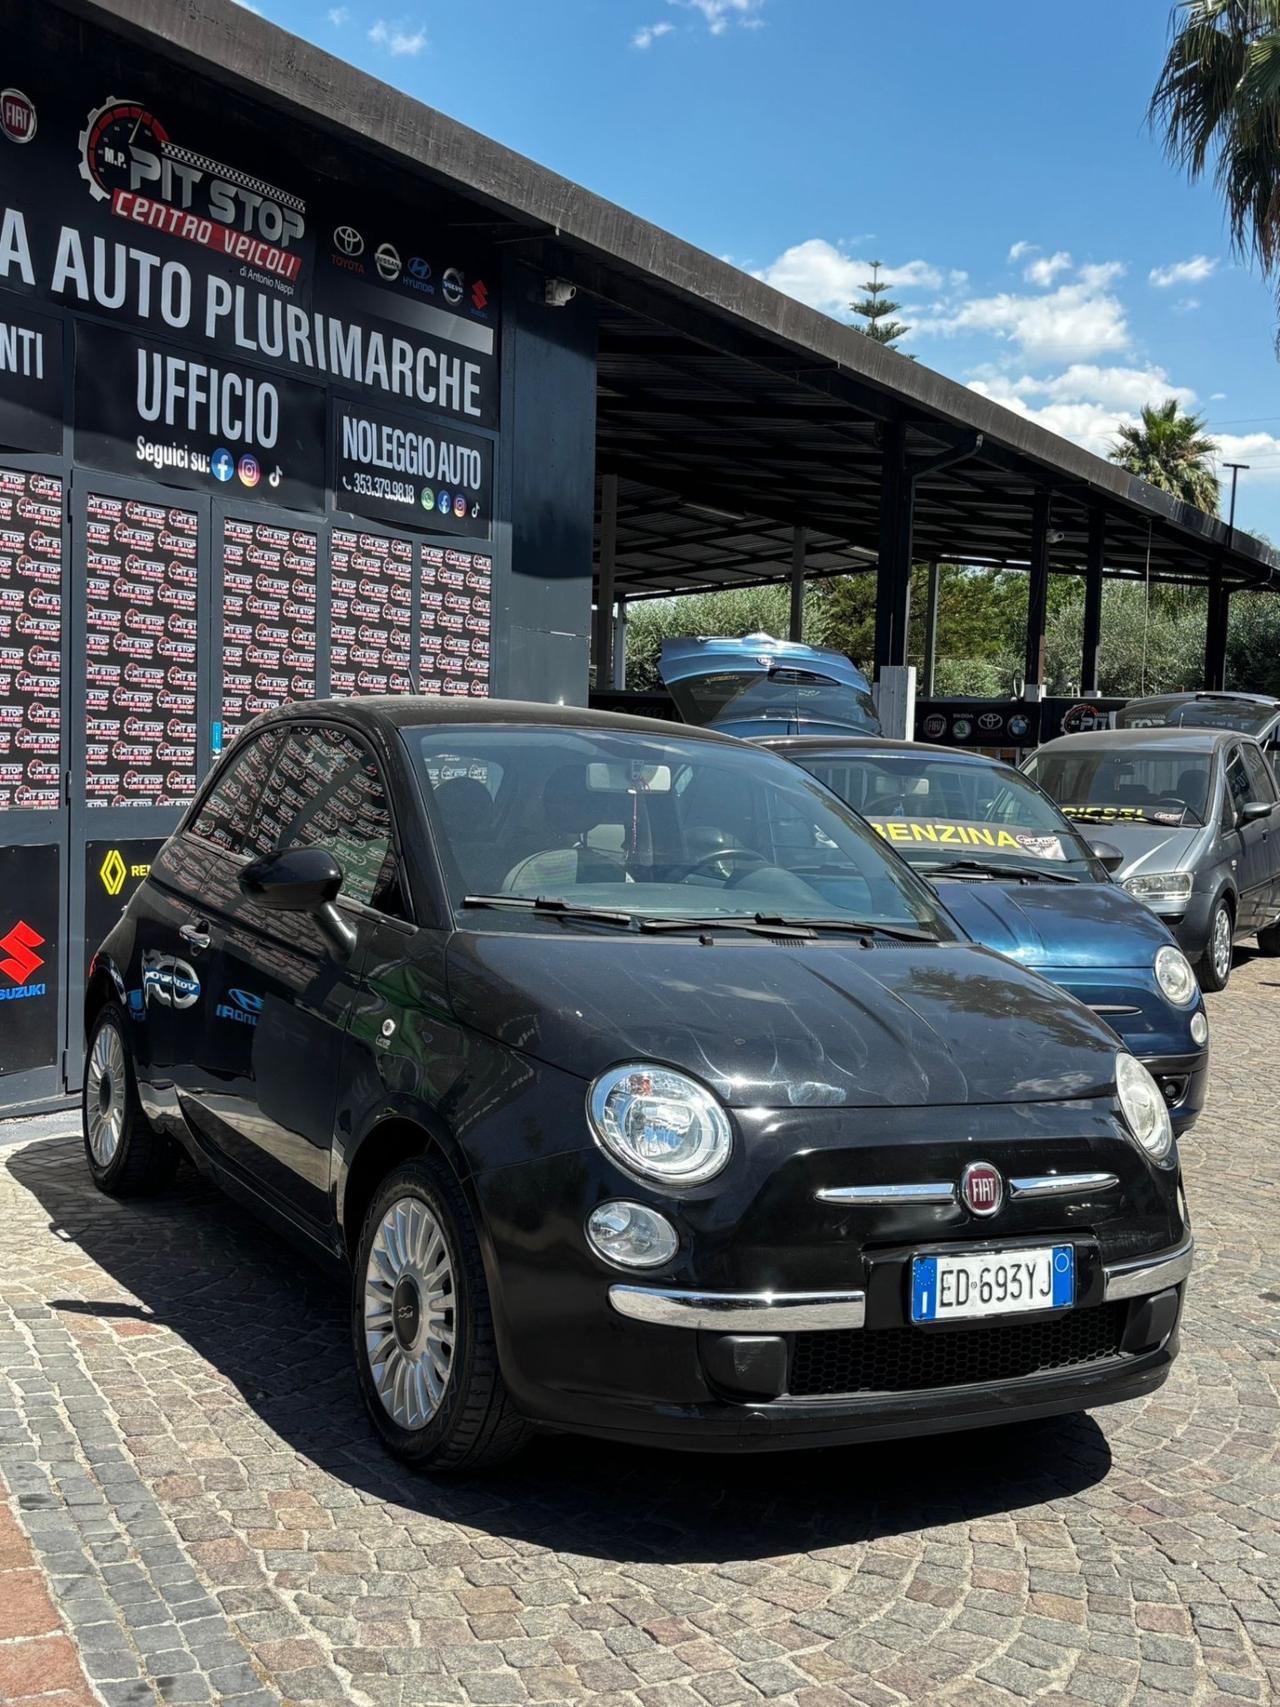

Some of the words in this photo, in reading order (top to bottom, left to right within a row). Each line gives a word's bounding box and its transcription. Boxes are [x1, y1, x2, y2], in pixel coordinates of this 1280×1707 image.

[5, 103, 30, 130] FIAT
[104, 147, 126, 168] M.P.
[130, 145, 203, 208] PIT
[208, 179, 305, 248] STOP
[331, 254, 365, 274] TOYOTA
[376, 256, 400, 268] NISSAN
[240, 266, 248, 277] di
[248, 268, 274, 287] Antonio
[274, 279, 294, 296] Nappi
[402, 276, 434, 295] HYUNDAI
[51, 226, 192, 328] AUTO
[205, 274, 481, 417] PLURIMARCHE
[137, 348, 278, 449] UFFICIO
[136, 435, 188, 470] Seguici
[190, 452, 210, 474] su:
[342, 416, 435, 478] NOLEGGIO
[438, 441, 481, 490] AUTO
[0, 983, 46, 1000] SUZUKI
[972, 1178, 994, 1202] FIAT
[940, 1268, 970, 1308] ED
[980, 1260, 1052, 1304] 693YJ
